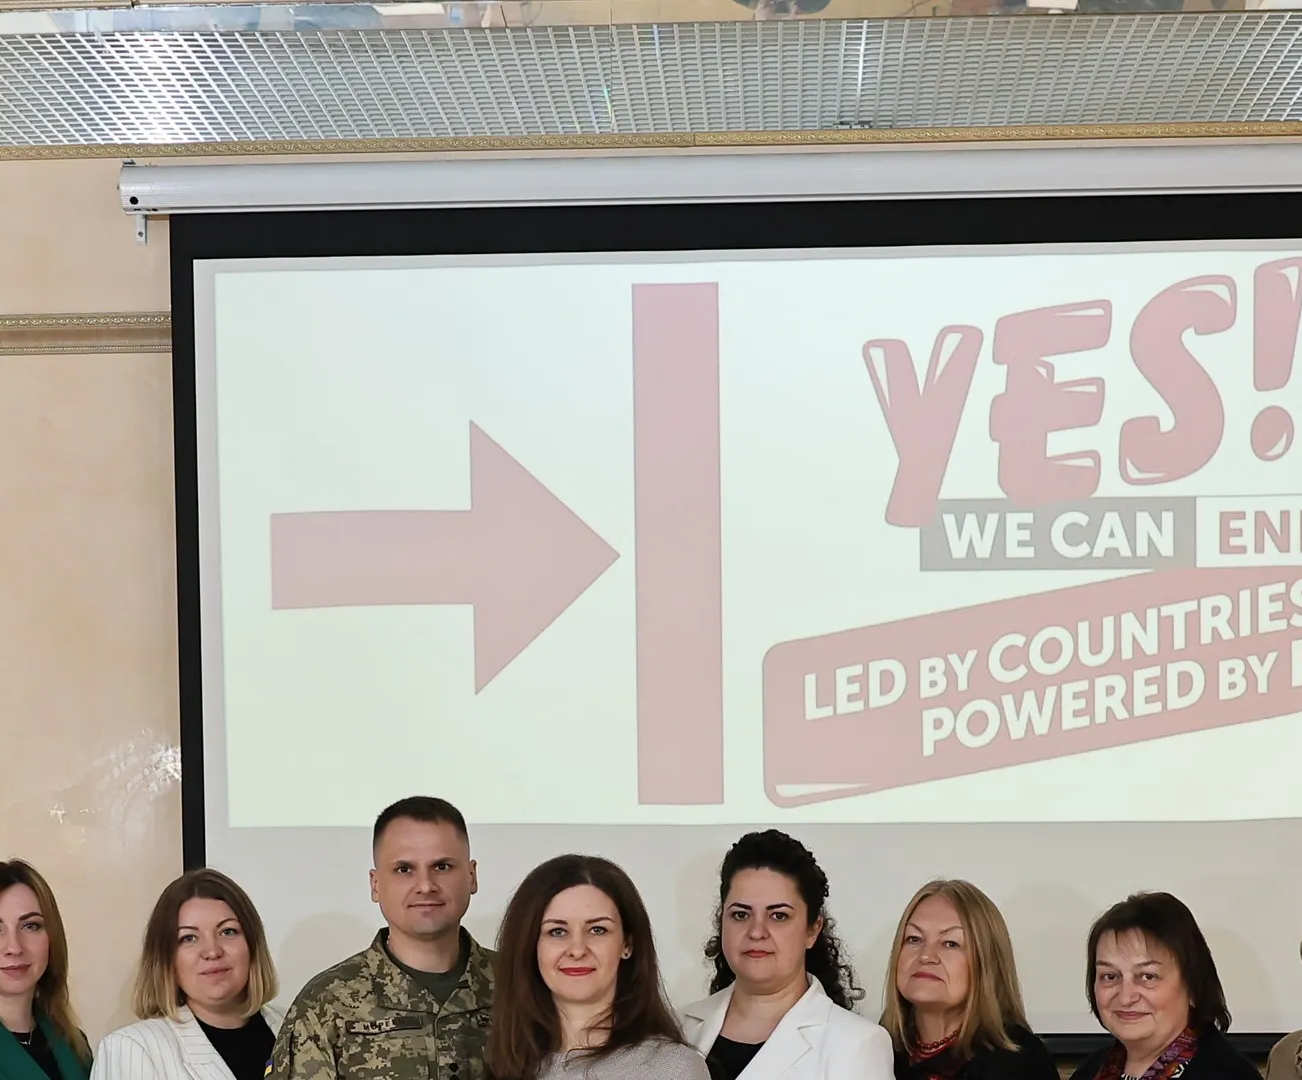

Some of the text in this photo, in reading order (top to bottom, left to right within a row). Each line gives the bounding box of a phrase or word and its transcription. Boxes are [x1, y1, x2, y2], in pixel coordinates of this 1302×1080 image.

[943, 509, 1177, 560] WE CAN
[802, 658, 908, 722] LED
[918, 649, 978, 701] BY
[920, 663, 1208, 758] POWERED
[1217, 651, 1276, 702] BY
